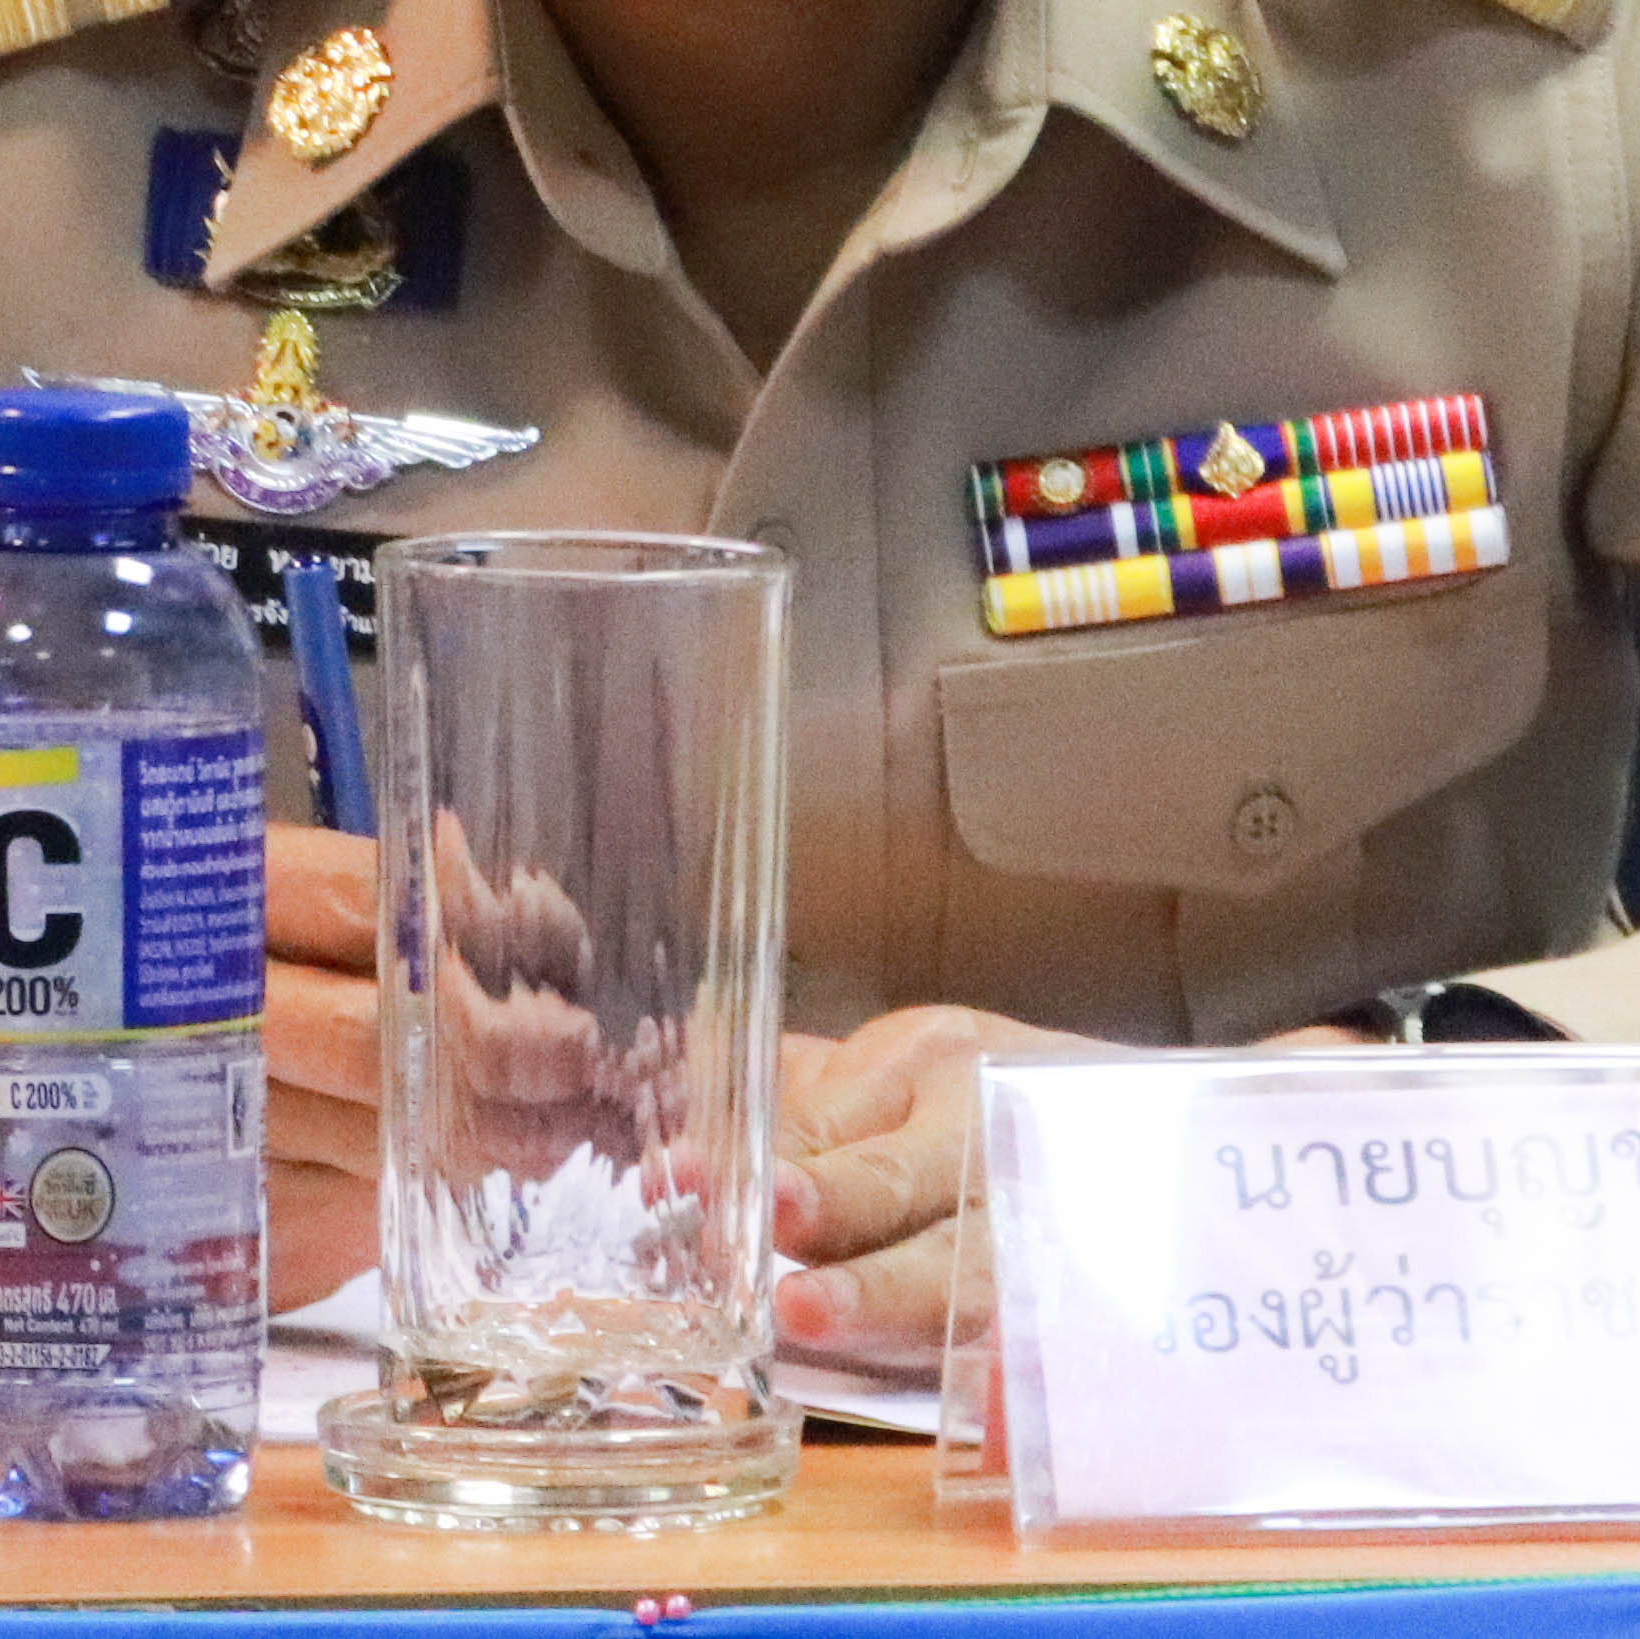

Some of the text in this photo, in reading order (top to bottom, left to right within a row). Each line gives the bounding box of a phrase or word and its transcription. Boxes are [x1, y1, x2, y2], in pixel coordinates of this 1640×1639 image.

[10, 1081, 22, 1110] C
[25, 1080, 78, 1111] 200%
[55, 1281, 96, 1316] 470
